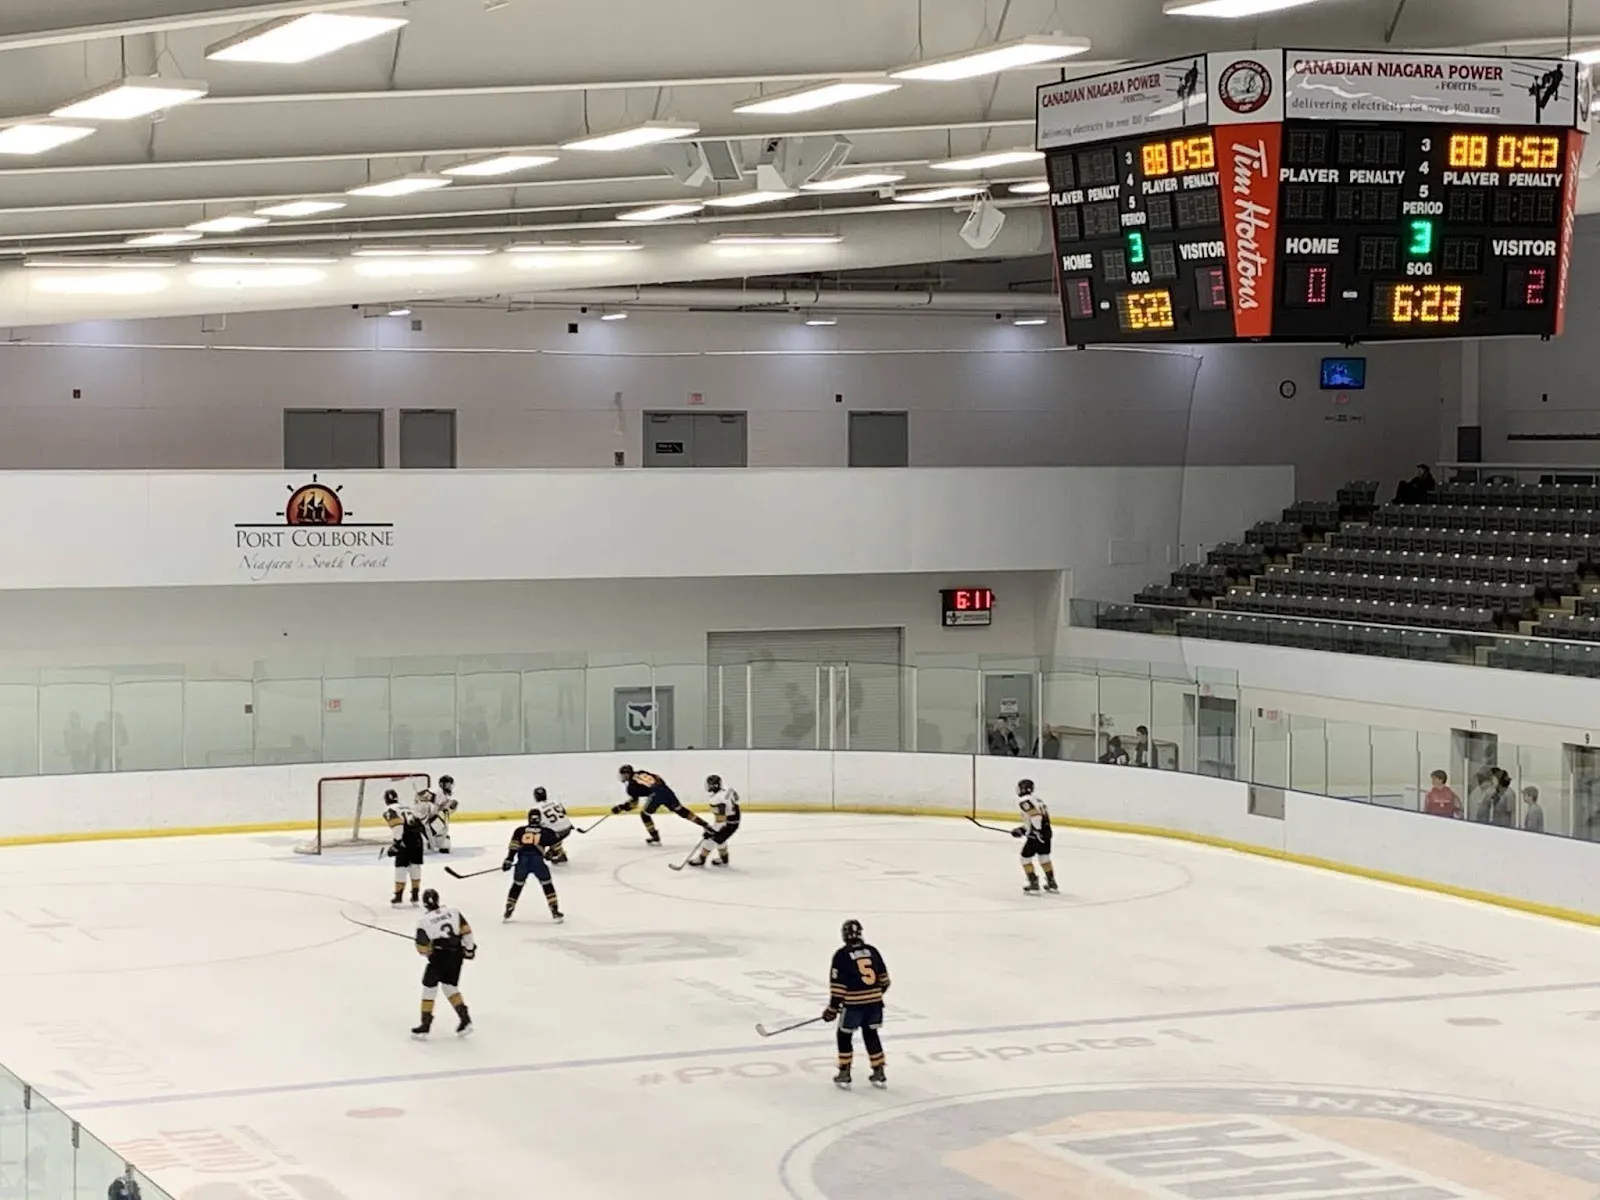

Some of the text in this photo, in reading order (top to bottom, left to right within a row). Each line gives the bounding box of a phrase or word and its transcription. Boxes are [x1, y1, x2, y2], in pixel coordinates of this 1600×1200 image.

[1293, 60, 1504, 81] CANADIAN NIAGARA POWER
[1042, 73, 1162, 108] CANADIAN NIAGARA POWER
[1291, 99, 1348, 112] delivering
[1421, 138, 1431, 152] 3
[1125, 152, 1133, 165] 3
[1231, 139, 1268, 195] Tim
[1280, 169, 1406, 184] PLAYER PENALTY
[1419, 161, 1429, 175] 4
[1126, 173, 1134, 187] 4
[1142, 171, 1220, 195] PLAYER PENALTY
[1443, 172, 1563, 188] PLAYER PENALTY
[1051, 184, 1120, 207] PLAYER PENALTY
[1419, 185, 1429, 199] 5
[1128, 196, 1136, 209] 5
[1402, 201, 1443, 216] PERIOD
[1121, 211, 1146, 227] PERIOD
[1410, 220, 1432, 254] 3
[1128, 232, 1144, 263] 3
[1179, 241, 1225, 260] VISITOR
[1234, 198, 1271, 309] Hortons
[1285, 237, 1340, 255] HOME
[1492, 239, 1557, 256] VISITOR
[1063, 253, 1093, 271] HOME
[1406, 262, 1433, 276] SOG
[1131, 270, 1150, 285] SOG
[291, 529, 394, 548] COLBORNE
[857, 958, 876, 985] 5
